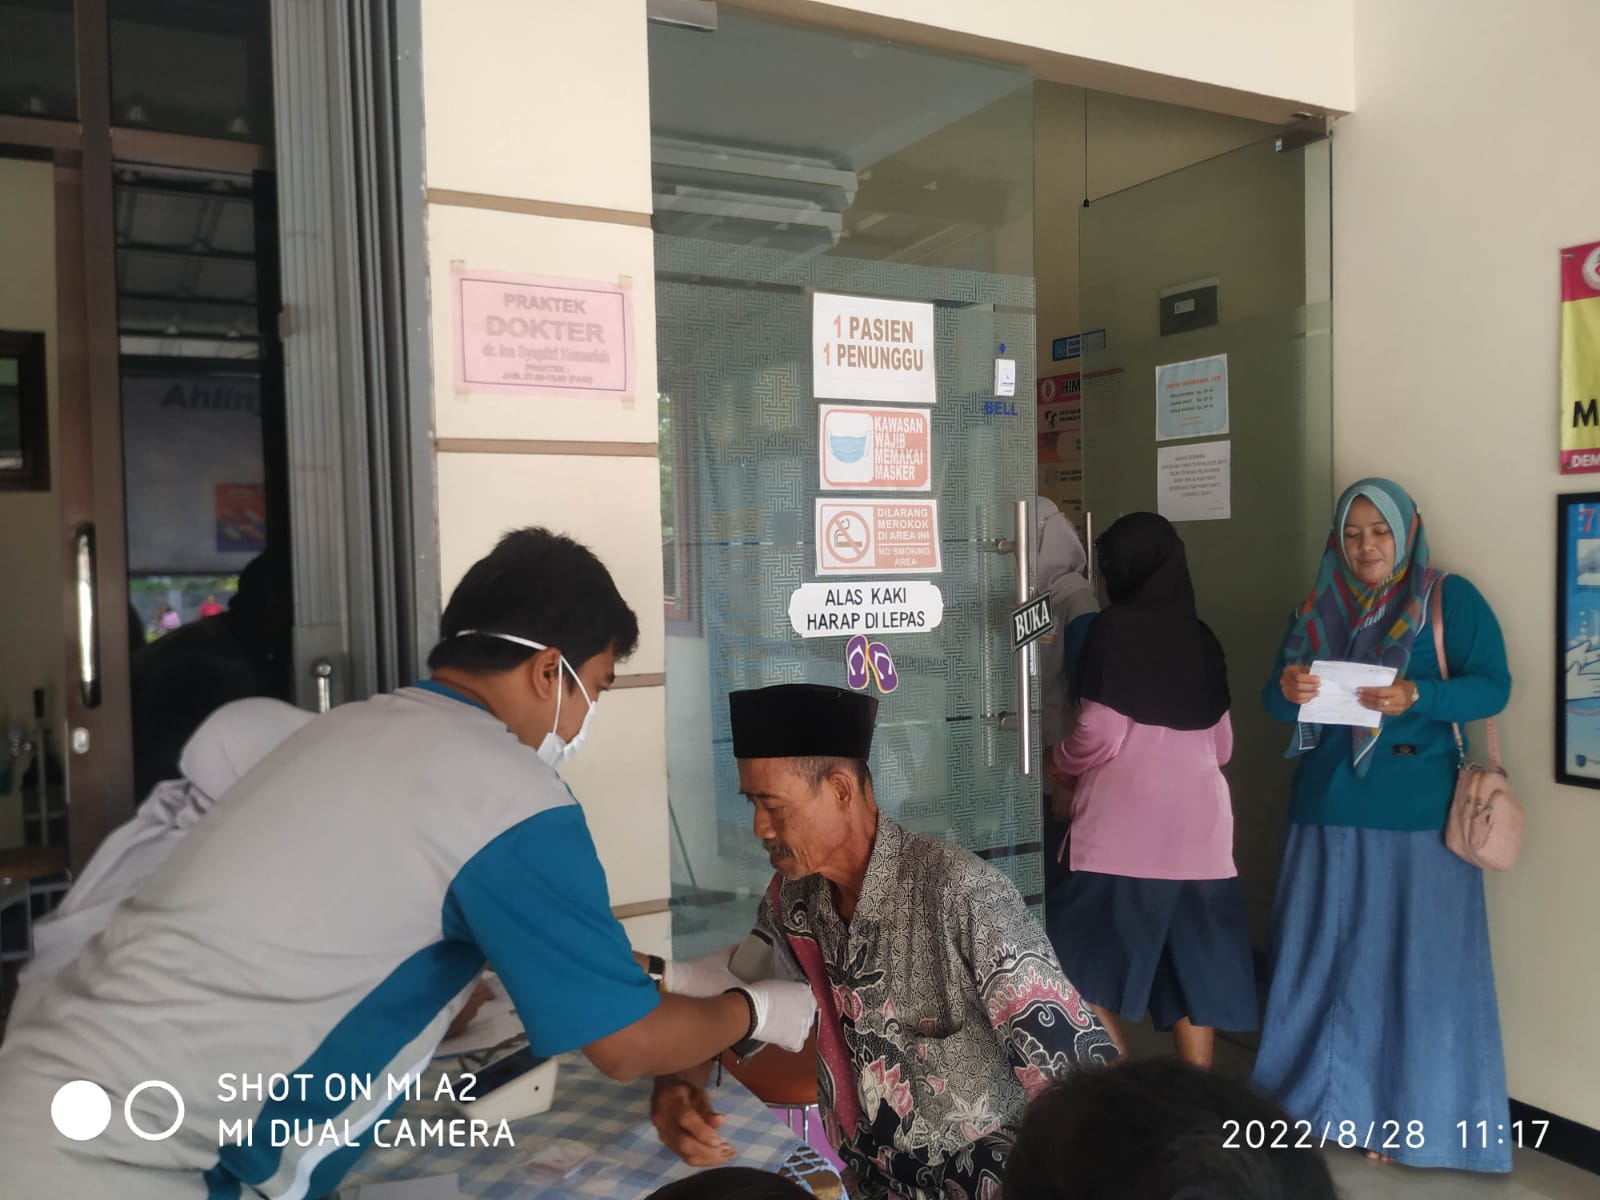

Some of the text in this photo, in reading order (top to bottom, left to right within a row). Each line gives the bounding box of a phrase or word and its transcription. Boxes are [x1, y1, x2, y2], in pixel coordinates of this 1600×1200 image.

[504, 293, 587, 314] PRAKTEK
[486, 315, 605, 343] DOKTER
[833, 315, 914, 343] 1 PASIEN
[823, 342, 924, 372] 1 PENUNGGU
[985, 401, 1018, 416] BELL
[1573, 399, 1599, 428] M
[874, 416, 923, 433] KAWASAN
[874, 432, 906, 448] WAJIB
[874, 448, 923, 465] MEMAKAI
[874, 464, 916, 481] MASKER
[877, 508, 928, 518] DILARANG
[877, 519, 929, 529] MEROKOK
[878, 531, 930, 541] DI AREA INI
[878, 547, 931, 556] NO SMOKING
[894, 557, 917, 566] AREA
[825, 587, 907, 606] ALAS KAKI
[807, 612, 861, 630] HARAP
[882, 610, 925, 628] LEPAS
[1014, 600, 1051, 642] BUKA
